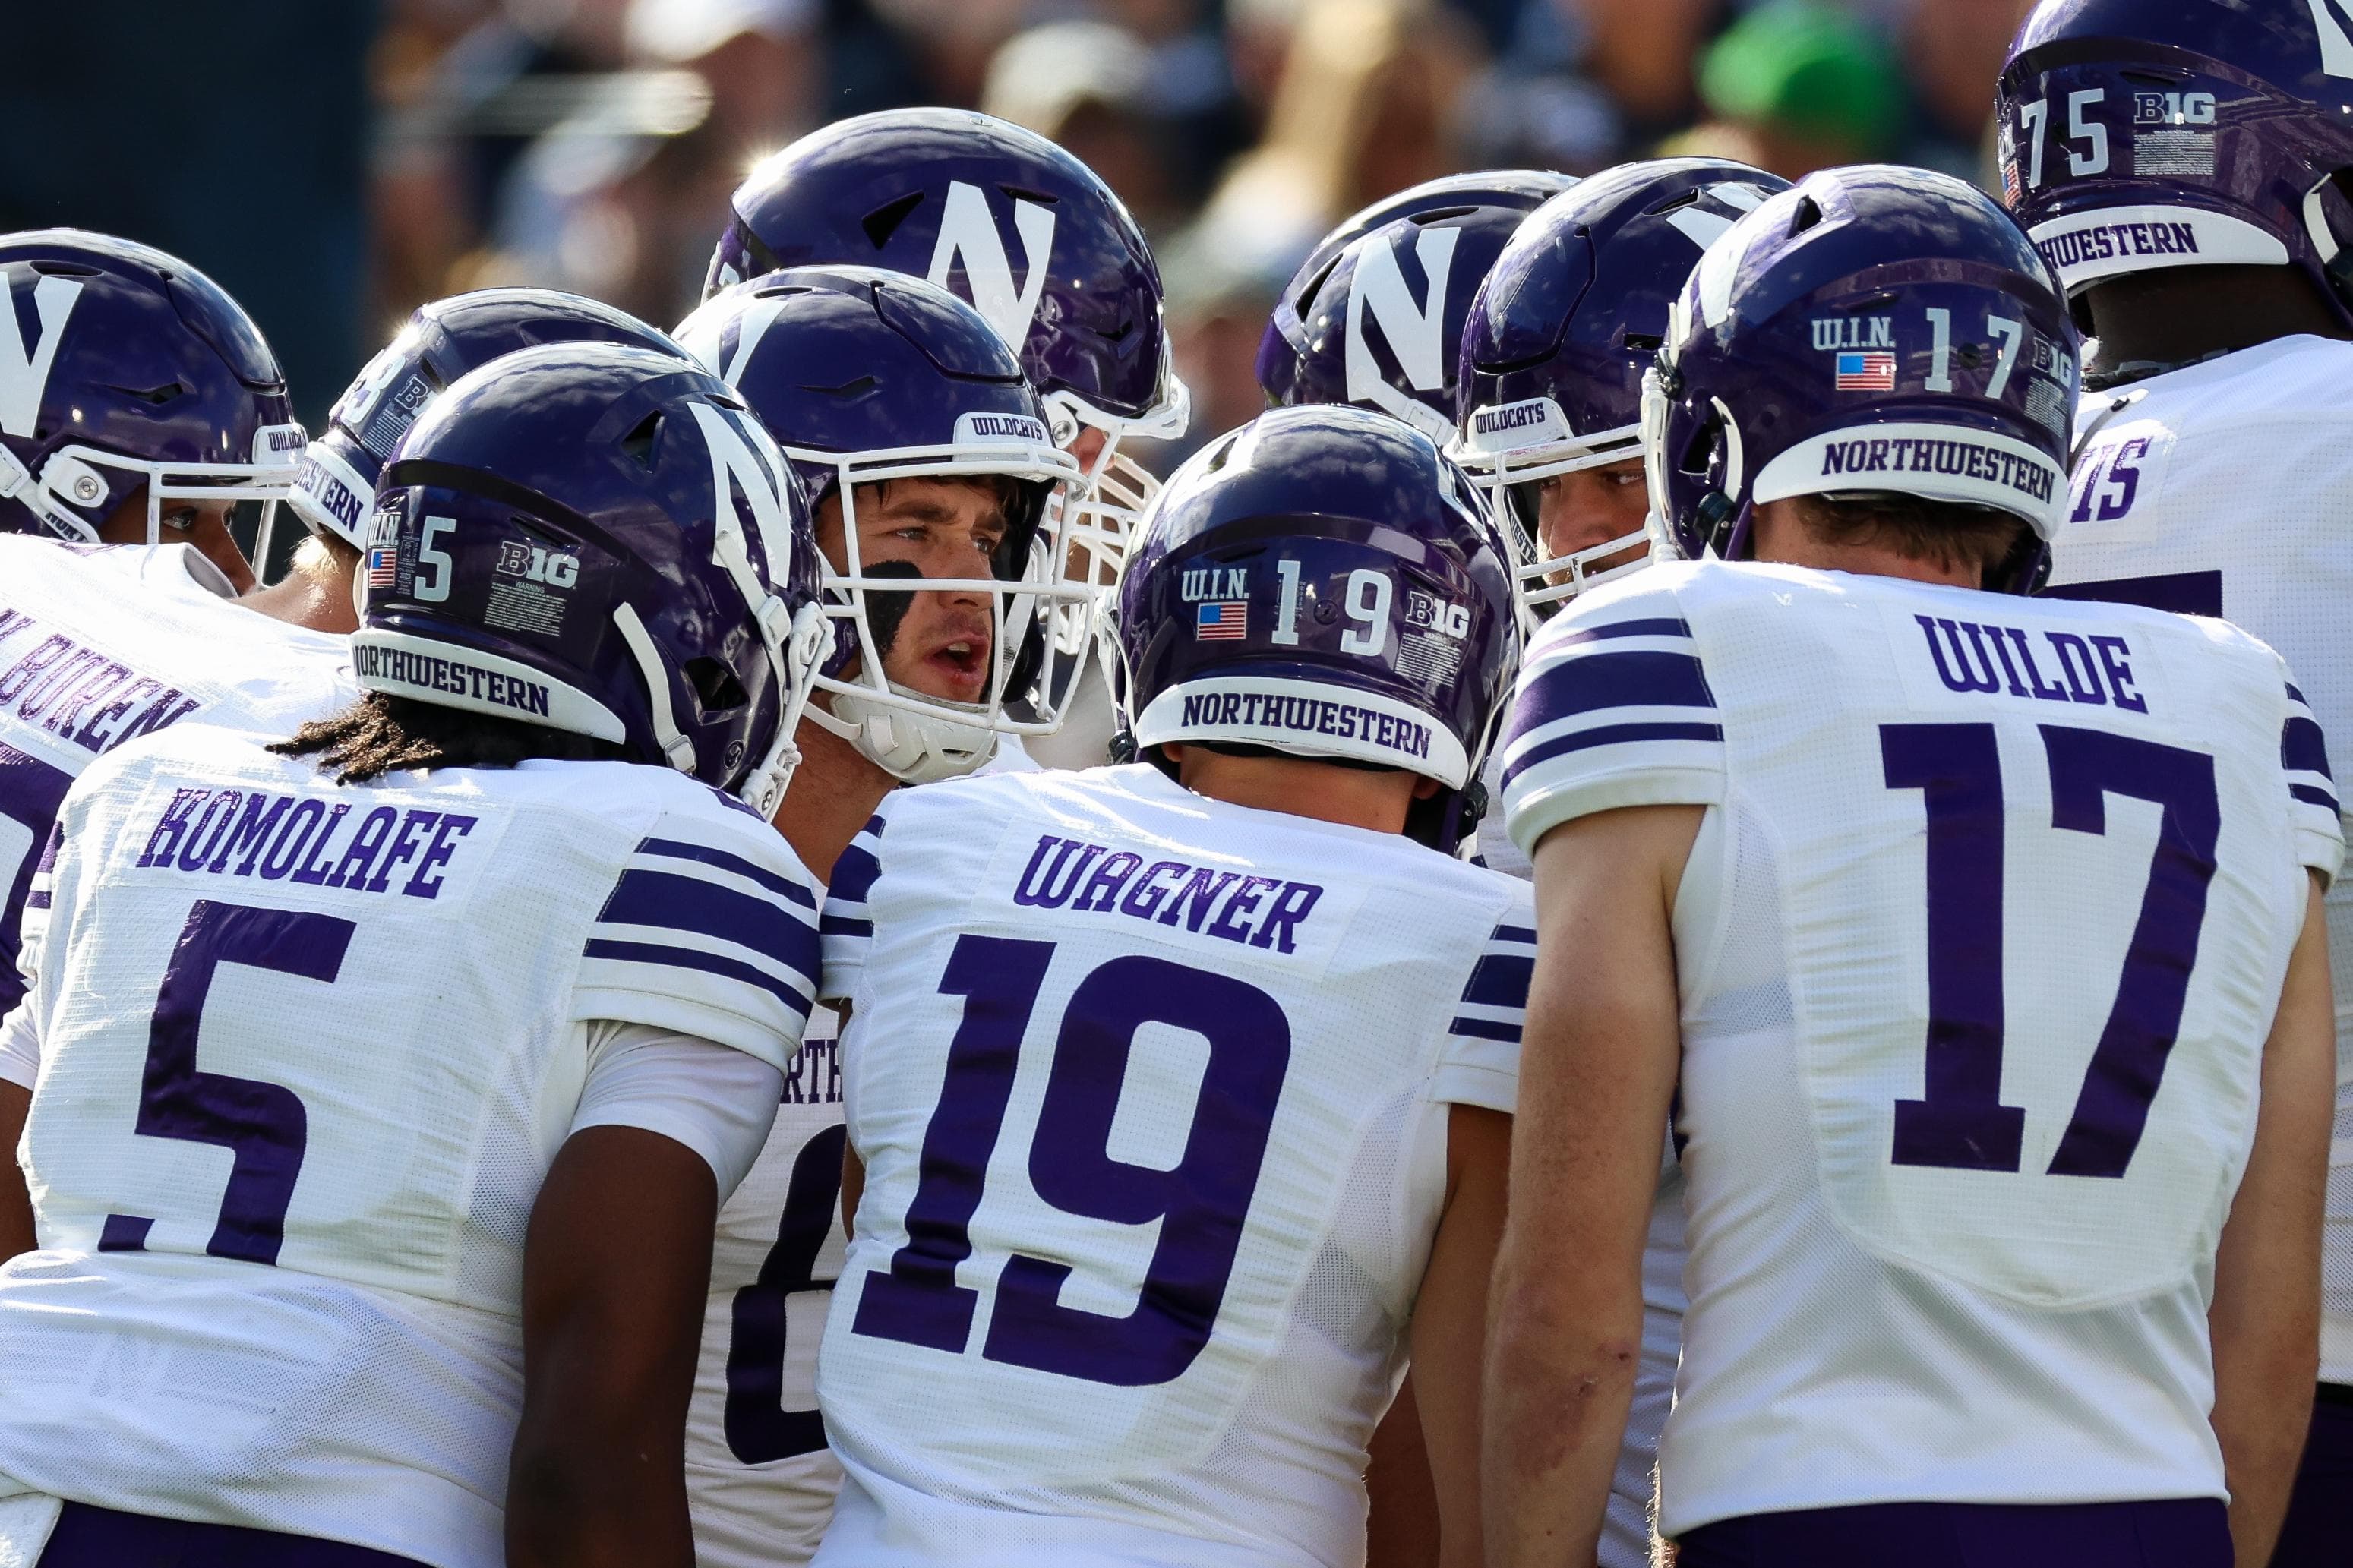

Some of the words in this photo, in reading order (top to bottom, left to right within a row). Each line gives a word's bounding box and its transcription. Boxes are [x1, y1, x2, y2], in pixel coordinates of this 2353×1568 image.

[2021, 88, 2109, 189] 75
[1345, 227, 1461, 402] N
[1925, 308, 2023, 399] 17
[971, 417, 1043, 440] WILDCATS
[1475, 402, 1546, 434] WILDCATS
[686, 402, 791, 589] N
[1821, 439, 2056, 506] NORTHWESTERN
[414, 516, 457, 602] 5
[1271, 560, 1393, 658] 19
[1914, 614, 2149, 715] WILDE
[1181, 692, 1432, 759] NORTHWESTERN
[136, 787, 479, 900] KOMOLAFE
[1013, 834, 1325, 956] WAGNER
[1878, 722, 2222, 1179] 17
[99, 899, 357, 1267] 5
[851, 933, 1292, 1387] 19
